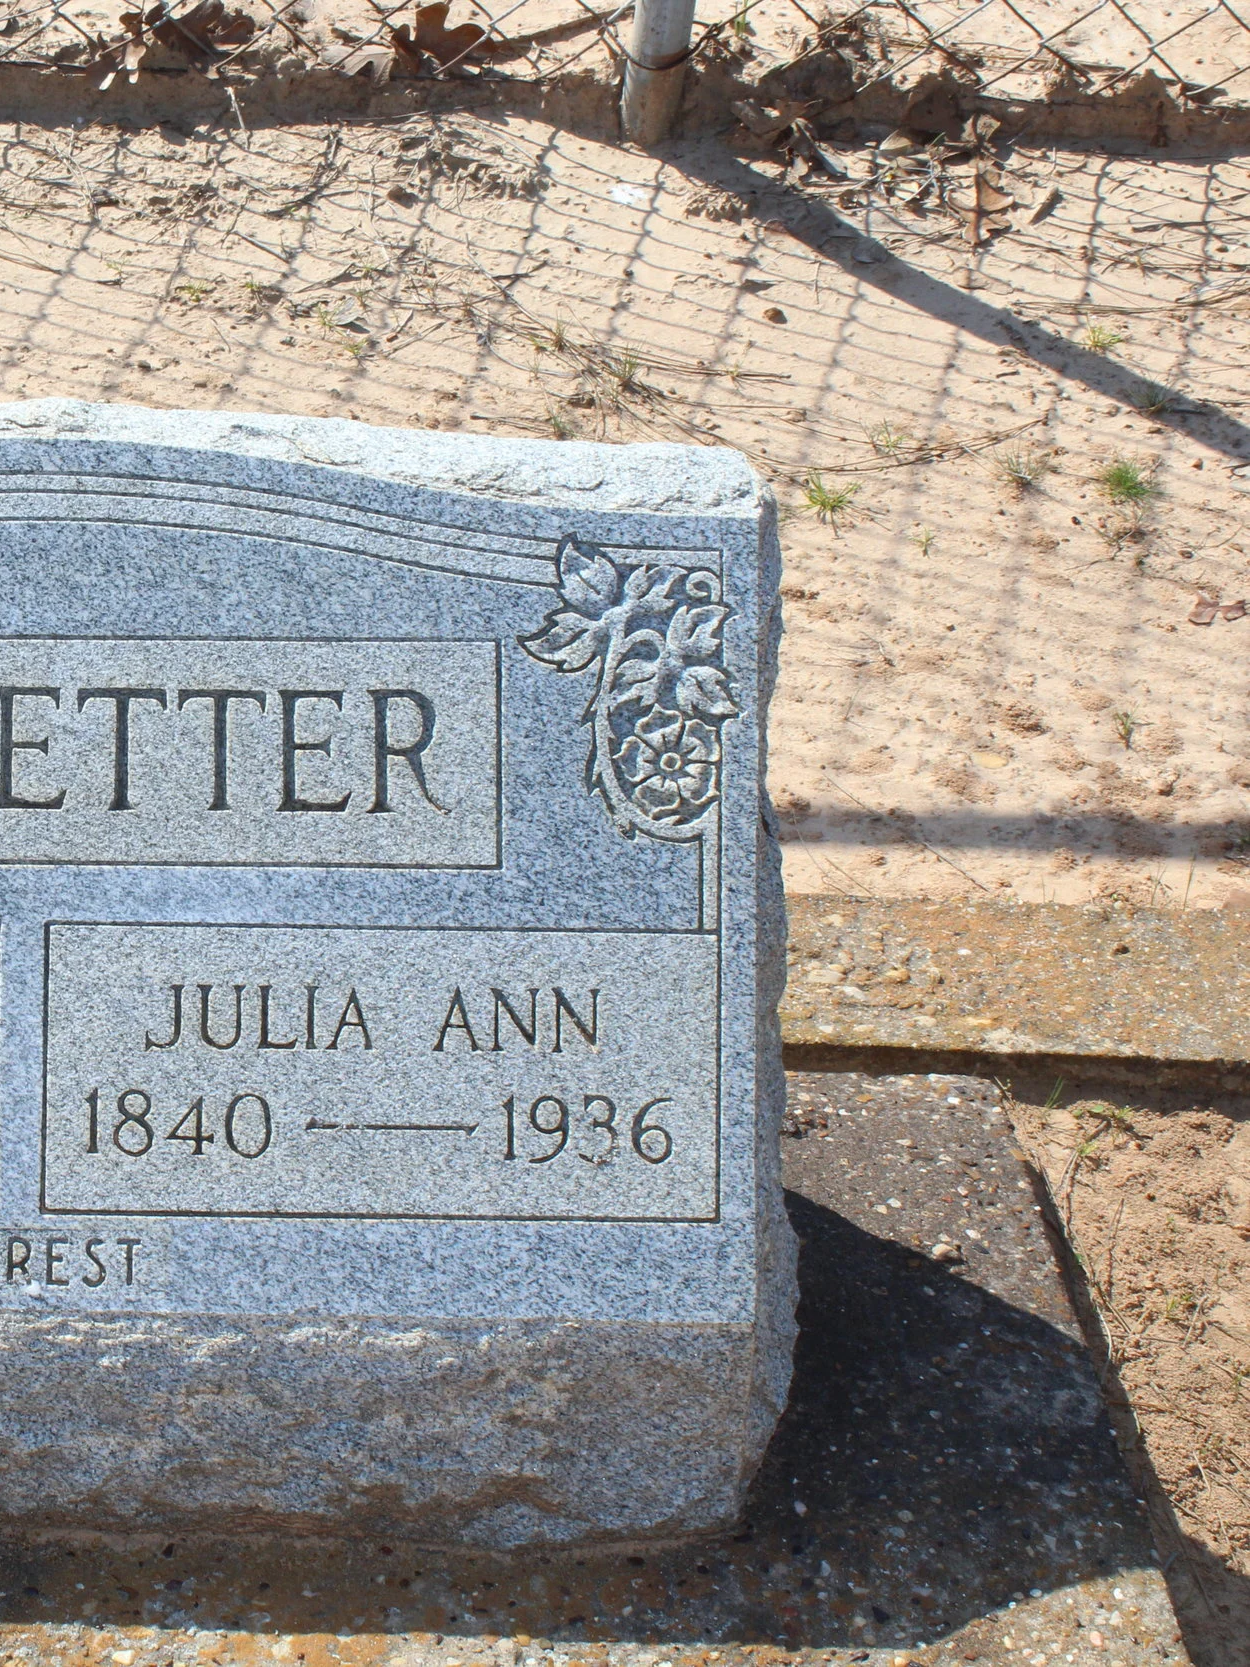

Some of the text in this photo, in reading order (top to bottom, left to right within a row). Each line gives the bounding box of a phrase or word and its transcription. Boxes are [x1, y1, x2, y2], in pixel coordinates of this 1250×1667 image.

[145, 984, 600, 1054] JULIA ANN
[86, 1087, 673, 1165] 1840 1936
[7, 1236, 141, 1288] REST
